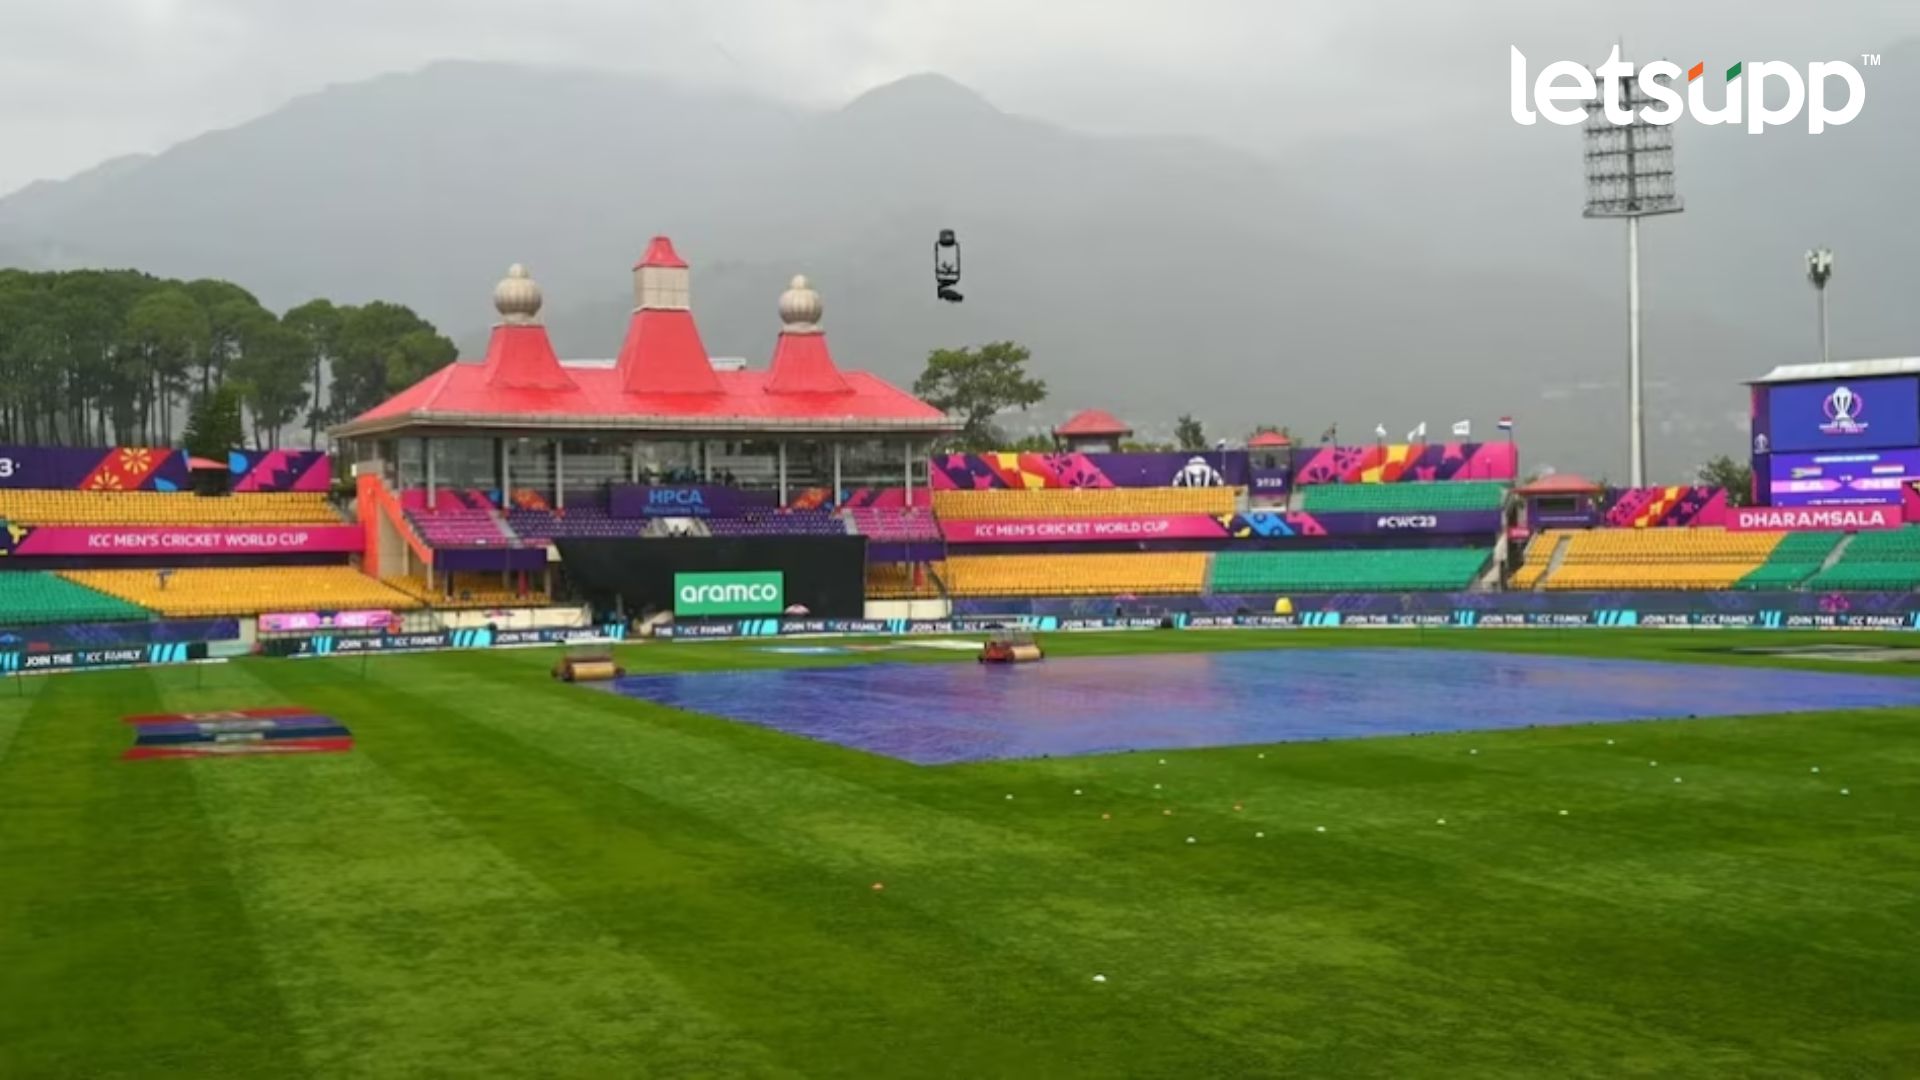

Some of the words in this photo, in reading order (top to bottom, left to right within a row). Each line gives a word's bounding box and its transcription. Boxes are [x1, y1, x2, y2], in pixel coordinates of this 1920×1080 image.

[649, 489, 703, 504] HPCA
[1377, 516, 1437, 529] #CWC23
[1739, 511, 1885, 528] DHARAMSALA
[975, 524, 994, 536] ICC
[996, 523, 1036, 536] MEN'S
[1037, 522, 1090, 535] CRICKET
[1093, 521, 1141, 533] WORLD
[1143, 520, 1169, 532] CUP
[88, 534, 111, 546] ICC
[114, 533, 159, 546] MEN'S
[161, 533, 221, 546] CRICKET
[224, 533, 277, 545] WORLD
[279, 532, 308, 545] CUP
[680, 583, 777, 602] aramco
[26, 655, 49, 666] JOIN
[53, 654, 73, 664] THE
[104, 650, 142, 661] FAMILY
